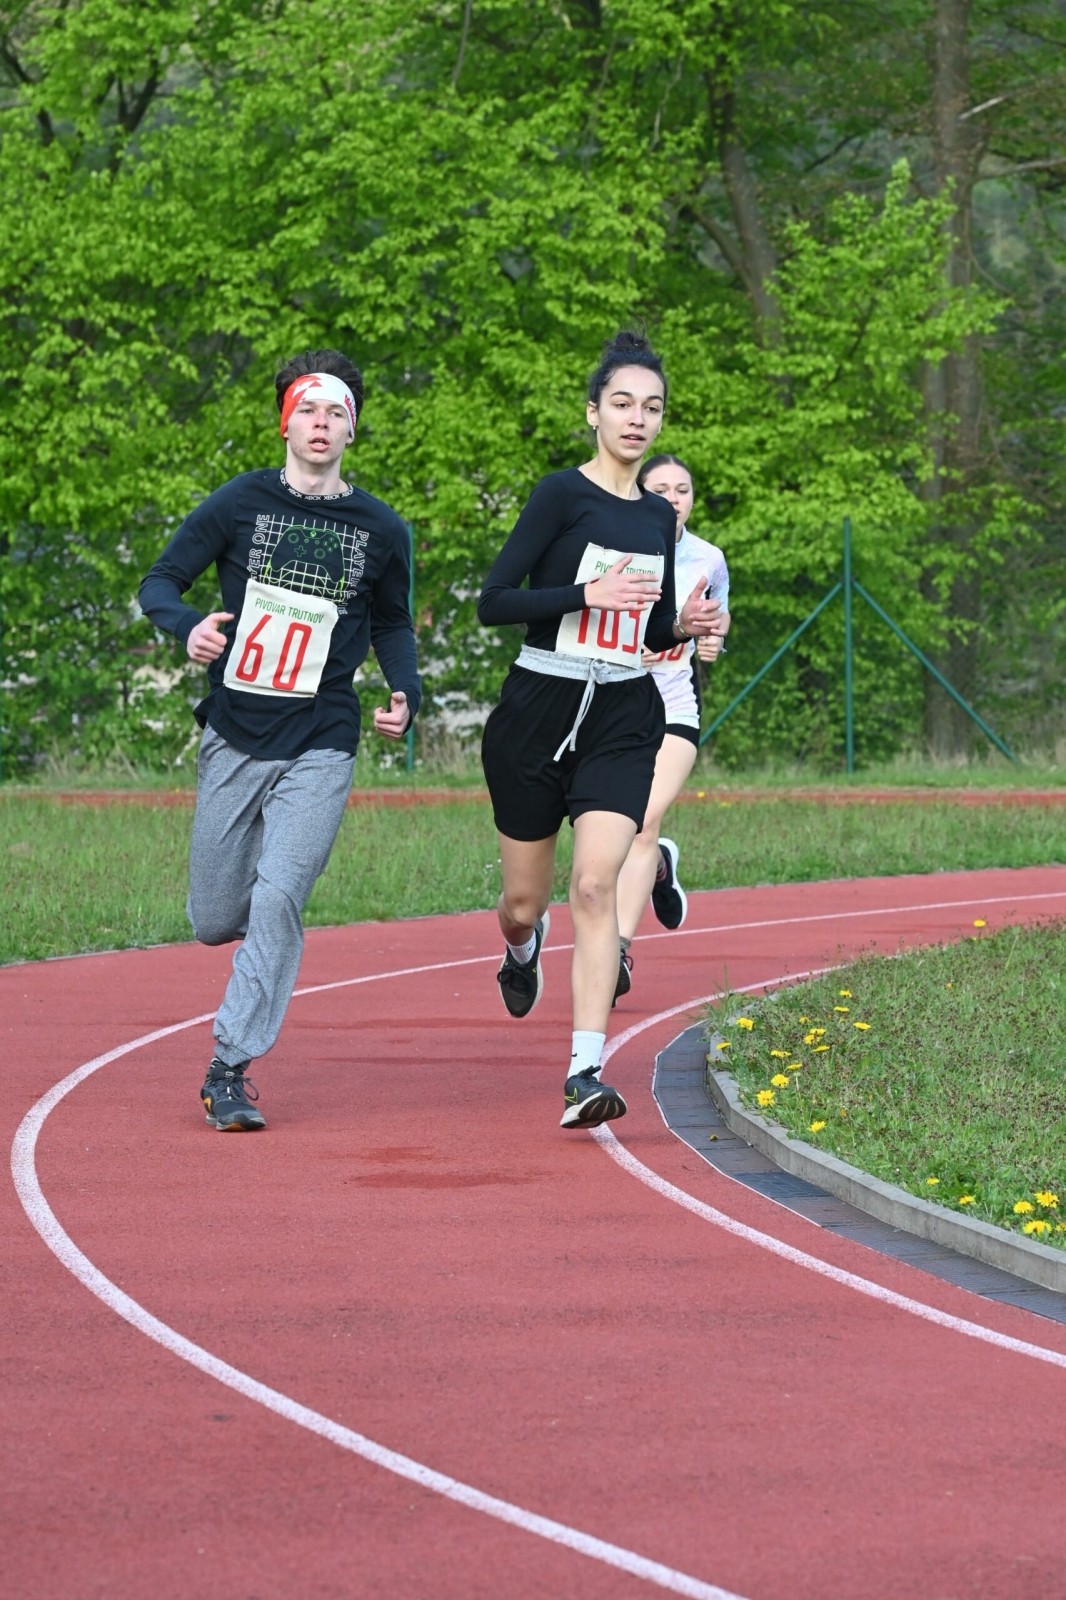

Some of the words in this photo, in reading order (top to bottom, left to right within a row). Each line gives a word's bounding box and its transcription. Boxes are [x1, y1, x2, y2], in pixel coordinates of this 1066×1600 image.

[323, 493, 341, 501] XBOX
[251, 514, 270, 545] ONE
[350, 530, 370, 588] PLAYER
[254, 597, 286, 616] PIVOVAR
[288, 606, 325, 624] TRUTNOV
[235, 613, 313, 691] 60
